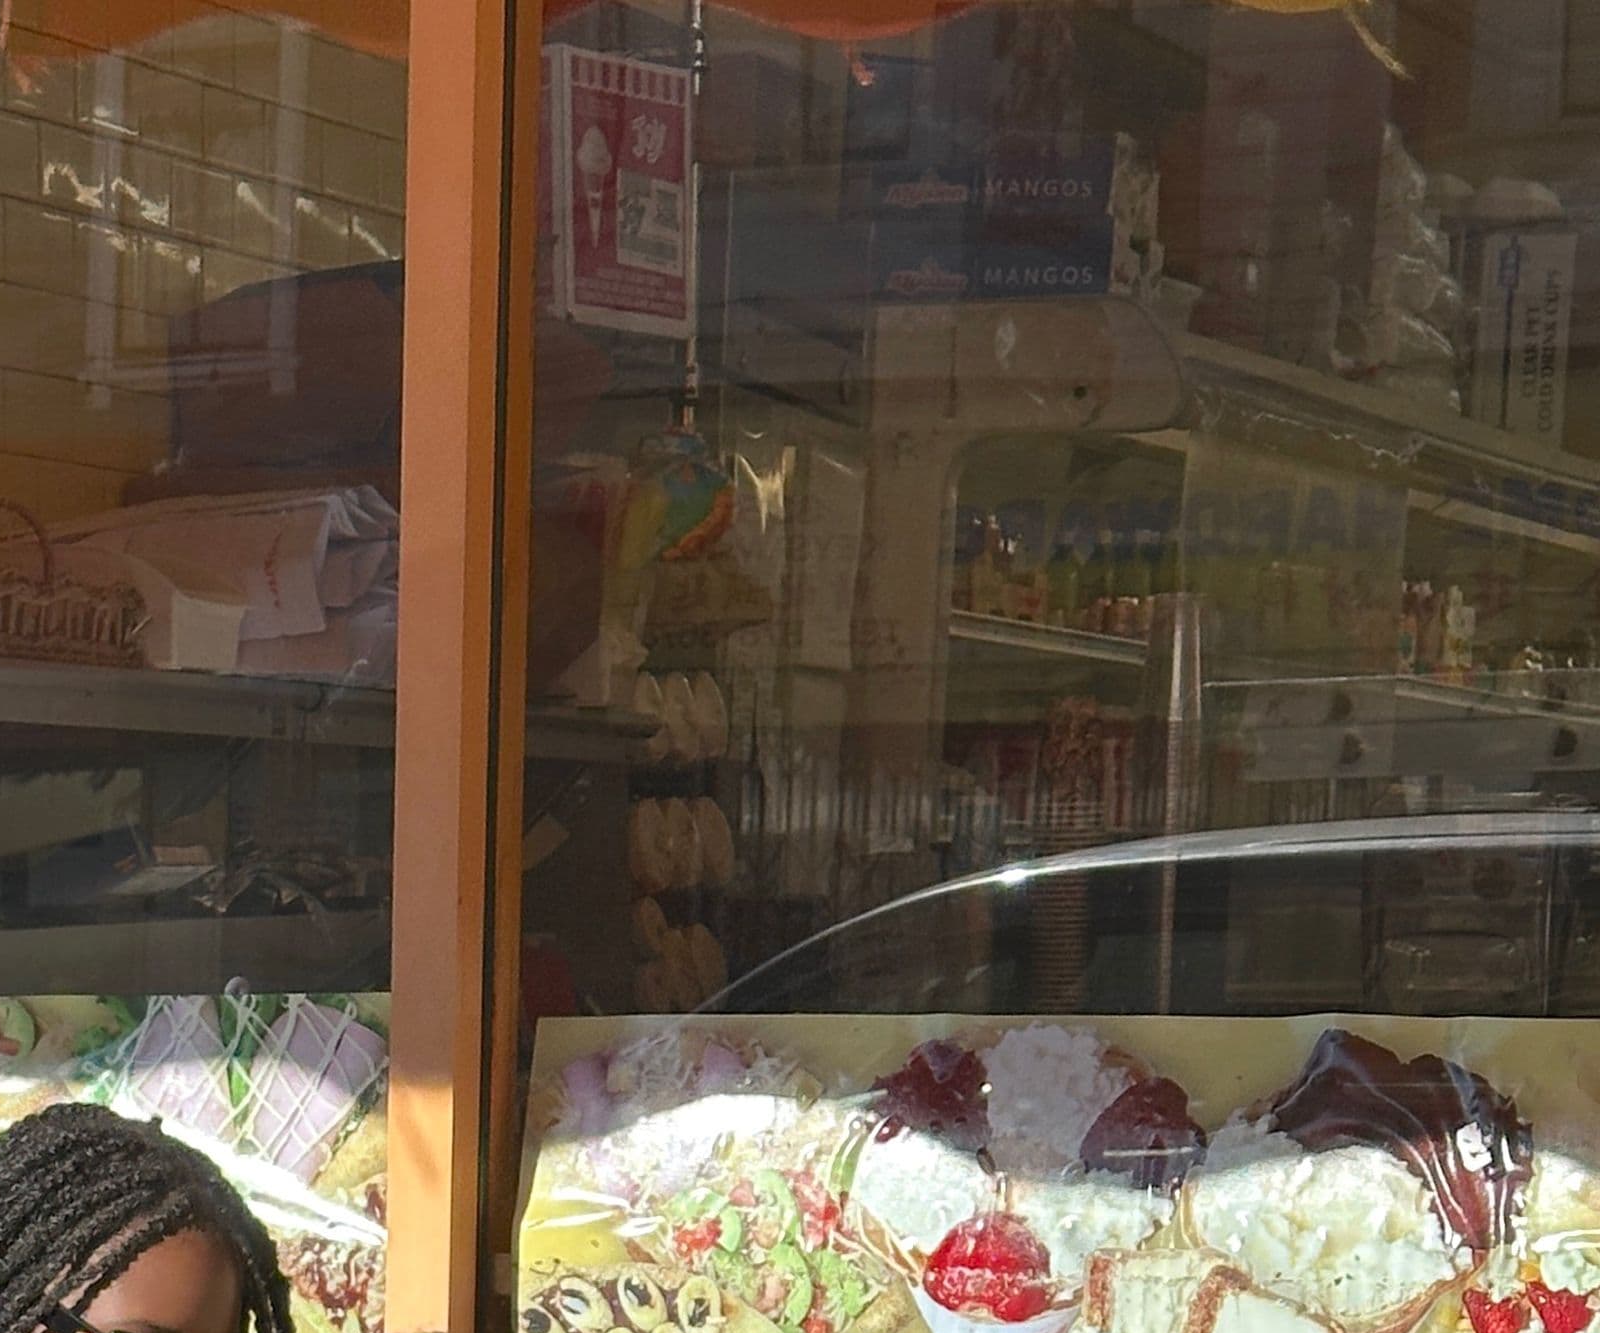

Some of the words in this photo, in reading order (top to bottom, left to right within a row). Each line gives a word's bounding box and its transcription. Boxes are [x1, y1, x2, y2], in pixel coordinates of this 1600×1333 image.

[984, 178, 1093, 198] MANGOS
[983, 265, 1094, 286] MANGOS
[1521, 345, 1538, 398] CLEAR
[1541, 321, 1557, 377] DRINK
[1537, 380, 1554, 432] COLD
